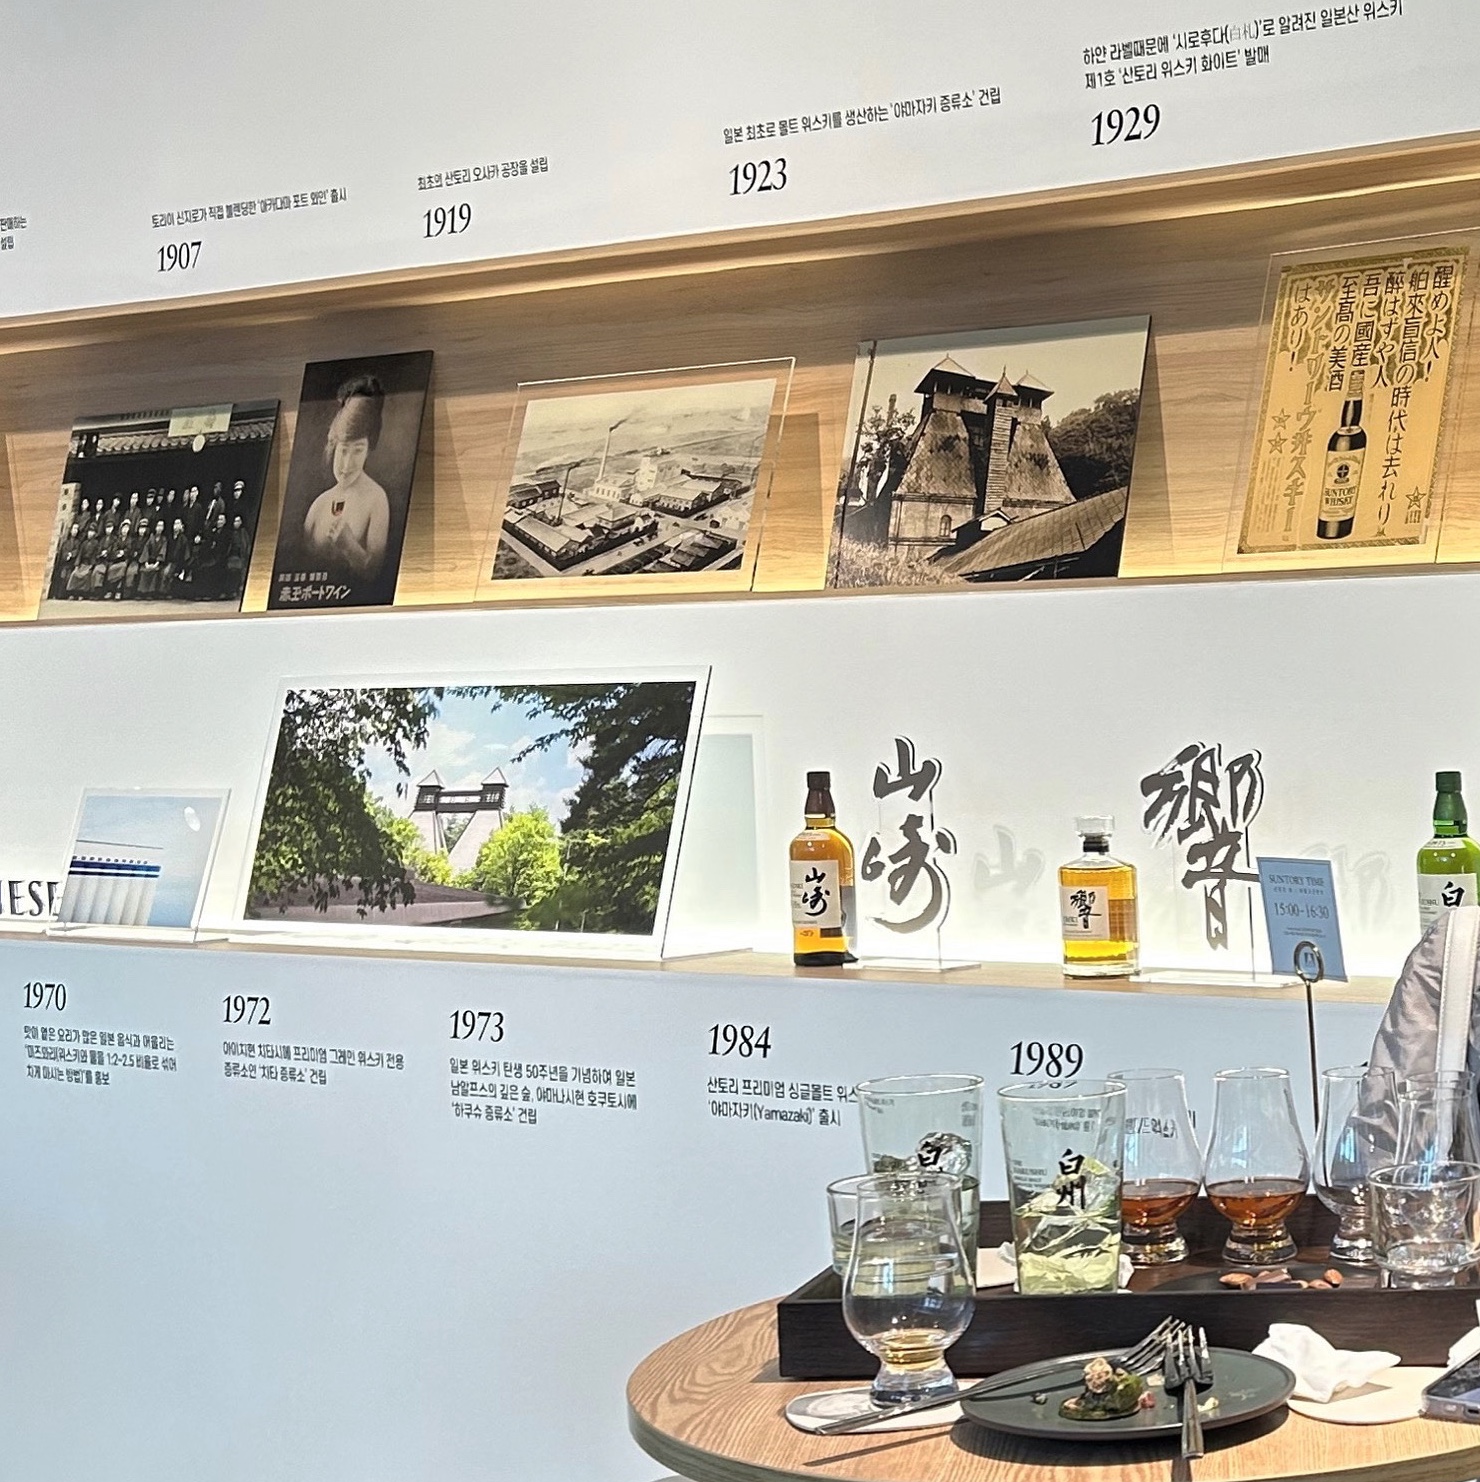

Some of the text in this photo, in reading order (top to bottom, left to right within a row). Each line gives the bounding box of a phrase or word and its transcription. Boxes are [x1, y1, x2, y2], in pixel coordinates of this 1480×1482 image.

[1083, 45, 1107, 65] 하얀
[1110, 35, 1169, 60] 라벨때문에
[1278, 11, 1317, 34] 알려진
[1320, 4, 1360, 28] 일본산
[1363, 0, 1402, 20] 위스키
[1086, 68, 1116, 89] 제1호
[1160, 56, 1198, 78] 위스키
[1245, 44, 1270, 66] 발매
[723, 126, 743, 144] 일본
[746, 122, 776, 141] 최초로
[778, 118, 799, 136] 몰트
[800, 110, 842, 133] 위스키를
[844, 104, 890, 127] 생산하는
[978, 86, 1002, 106] 건립
[1091, 103, 1160, 146] 1929
[417, 156, 549, 190] 최초의 산토리 오사카 공장을 설립
[728, 158, 788, 196] 1923
[152, 212, 175, 228] 토리이
[176, 208, 208, 226] 신지로가
[208, 205, 224, 220] 직접
[292, 192, 308, 208] 포트
[330, 188, 347, 204] 출시
[423, 202, 472, 238] 1919
[157, 241, 202, 272] 1907
[1140, 743, 1260, 950] 響
[1268, 874, 1325, 886] SUNTORY TIME
[1070, 890, 1102, 929] 響
[24, 982, 66, 1012] 1970
[222, 995, 272, 1025] 1972
[57, 1028, 80, 1044] 요리가
[117, 1032, 141, 1048] 음식과
[142, 1035, 175, 1051] 어울리는
[450, 1010, 504, 1042] 1973
[708, 1024, 772, 1058] 1984
[223, 1041, 405, 1070] 아이치현 치타시에 프리미엄 그레인 위스키 전용
[1010, 1041, 1084, 1079] 1989
[42, 1066, 64, 1082] 마시는
[224, 1062, 257, 1079] 증류소인
[310, 1068, 327, 1085] 건립
[450, 1057, 636, 1088] 일본 위스키 탄생 50주년을 기념하여 일본
[450, 1080, 498, 1098] 남알프스의
[500, 1084, 519, 1101] 깊은
[536, 1086, 585, 1106] 야마나시현
[588, 1090, 638, 1110] 호쿠토시에
[707, 1076, 858, 1104] 산토리 프리미엄 싱글몰트 위스
[518, 1107, 538, 1124] 건립
[818, 1108, 842, 1127] 출시
[1058, 1148, 1086, 1210] 白州
